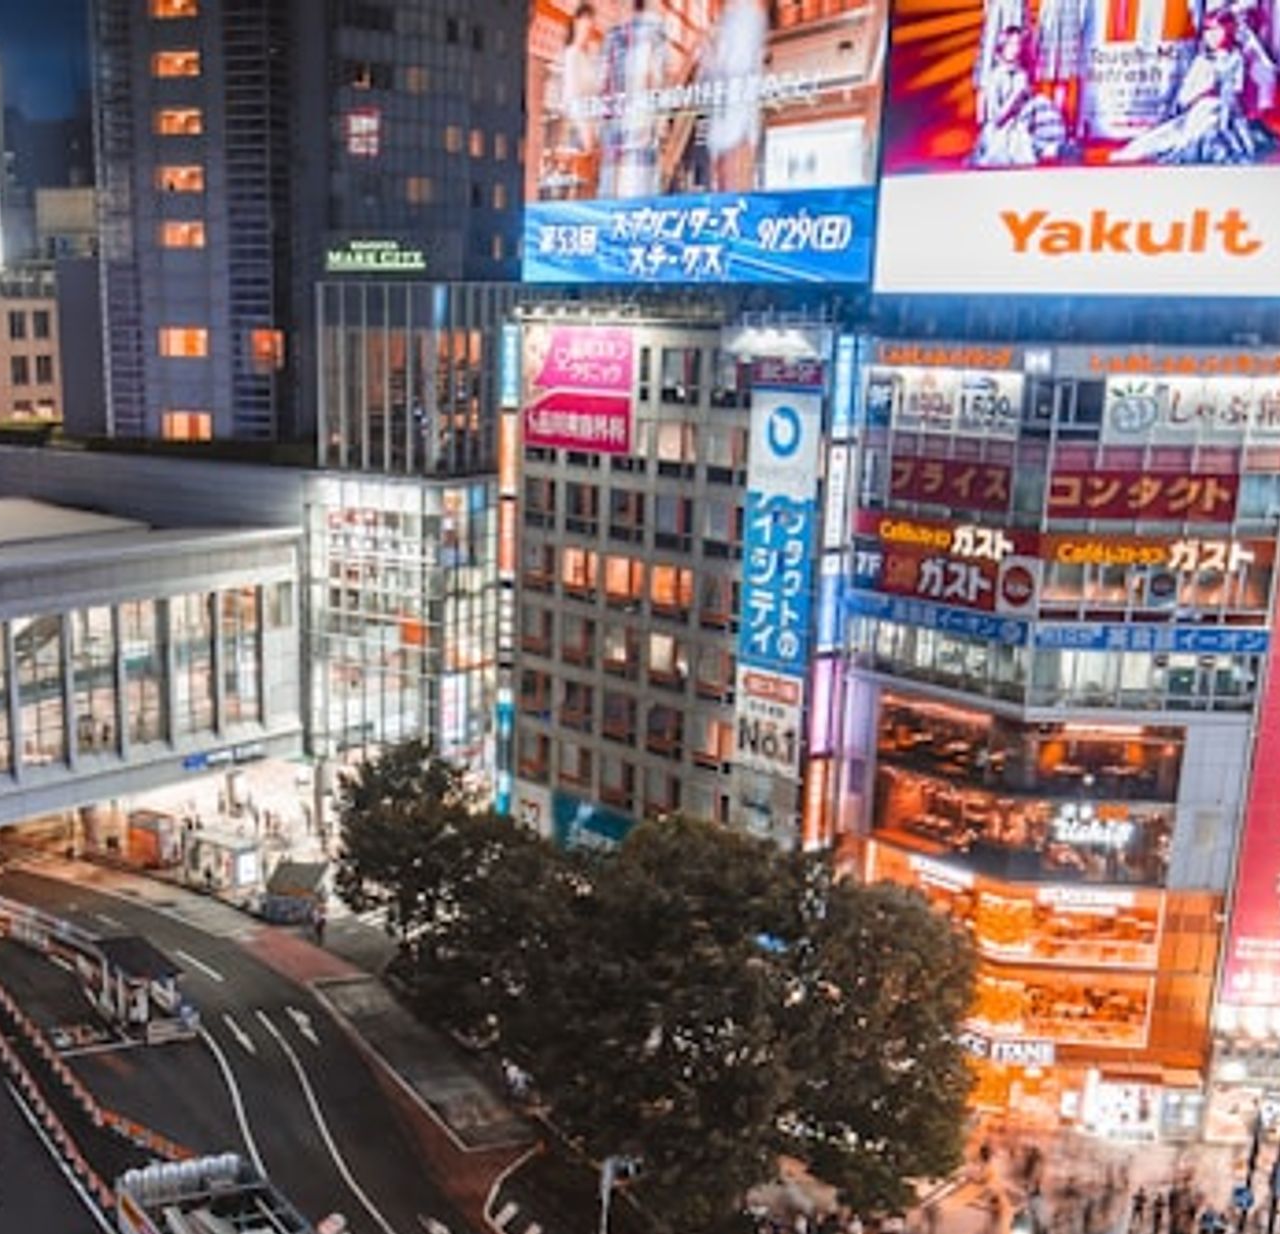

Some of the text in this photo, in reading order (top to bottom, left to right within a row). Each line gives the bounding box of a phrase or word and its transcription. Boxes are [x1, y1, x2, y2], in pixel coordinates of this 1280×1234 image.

[609, 199, 750, 240] スプリンターズ
[999, 208, 1265, 257] Yakult
[1048, 475, 1231, 514] コンタクト
[951, 524, 1015, 561] ガスト
[1168, 540, 1256, 572] ガスト
[917, 557, 993, 602] ガスト
[738, 715, 797, 766] No.1
